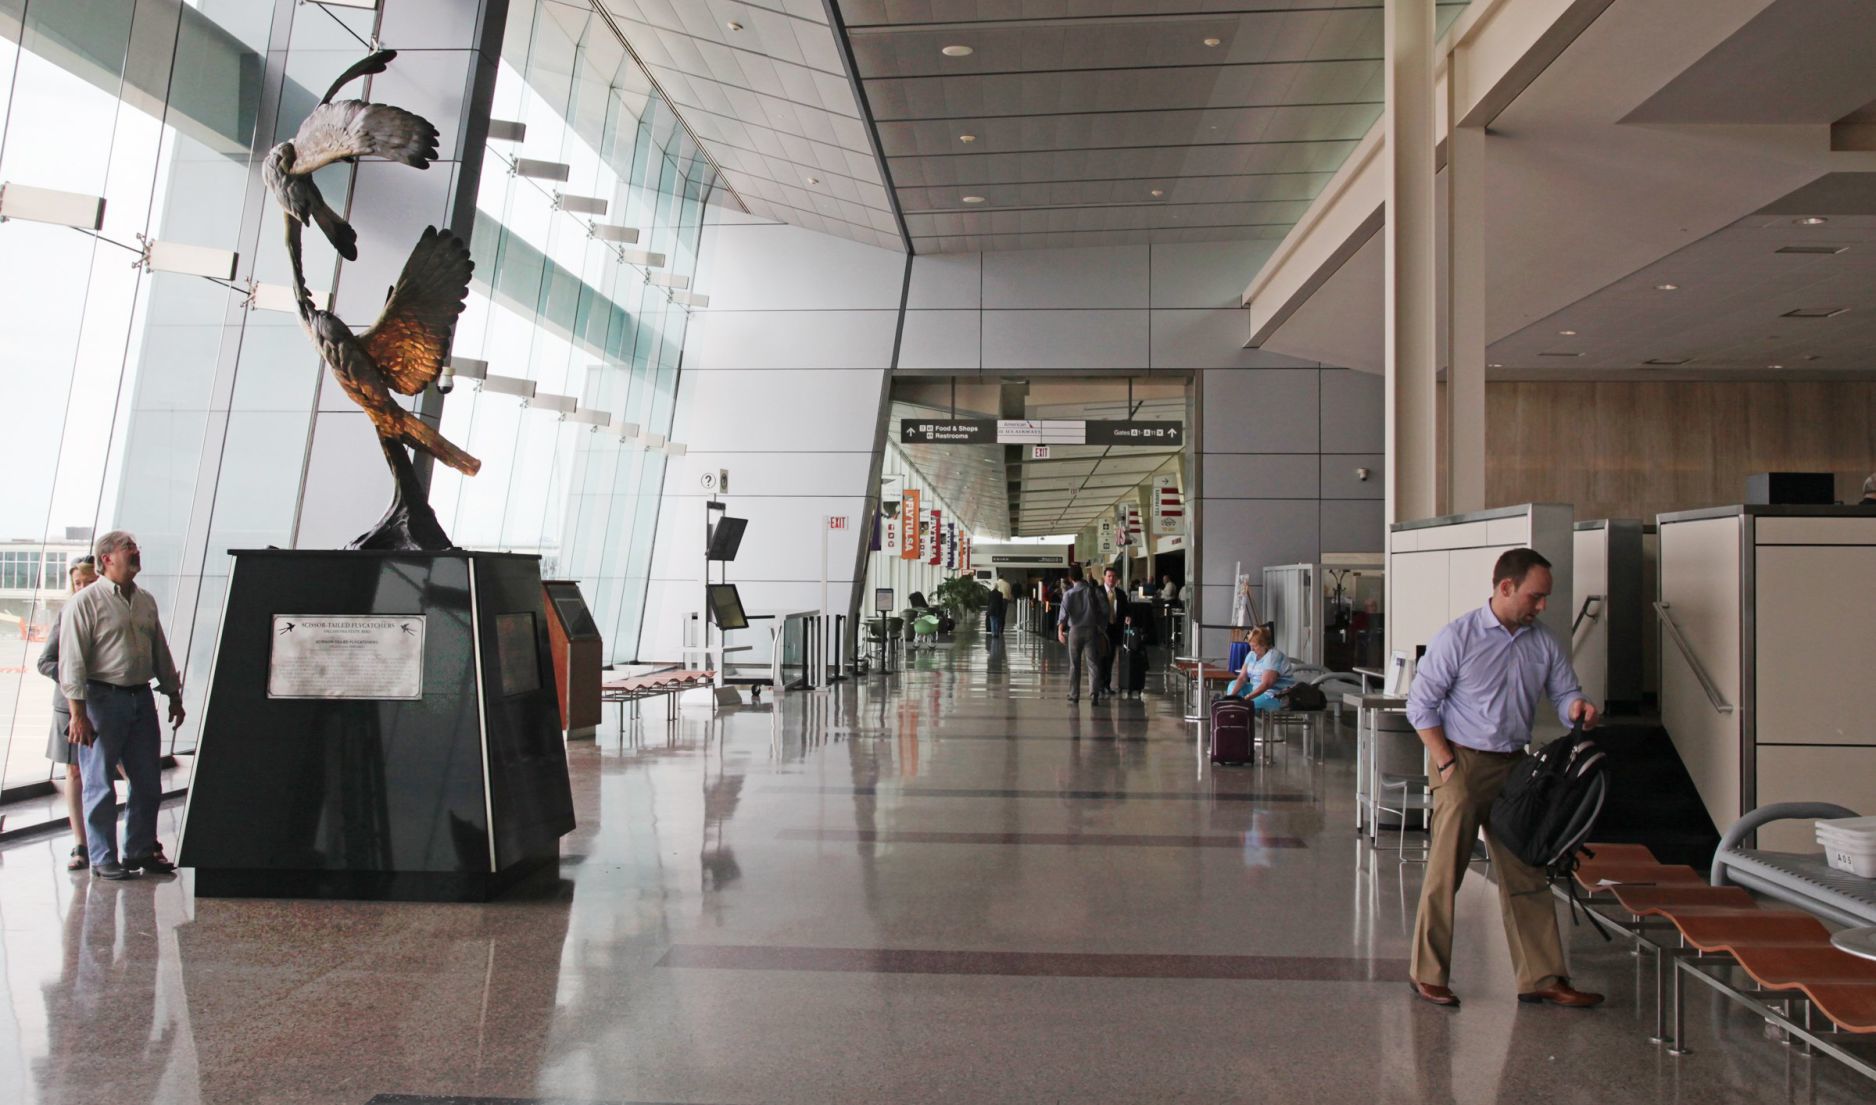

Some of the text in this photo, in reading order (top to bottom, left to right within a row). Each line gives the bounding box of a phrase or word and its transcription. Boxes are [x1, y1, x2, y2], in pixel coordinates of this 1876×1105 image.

[958, 425, 978, 433] Shops
[1035, 447, 1048, 458] EXIT
[830, 516, 846, 529] EXIT
